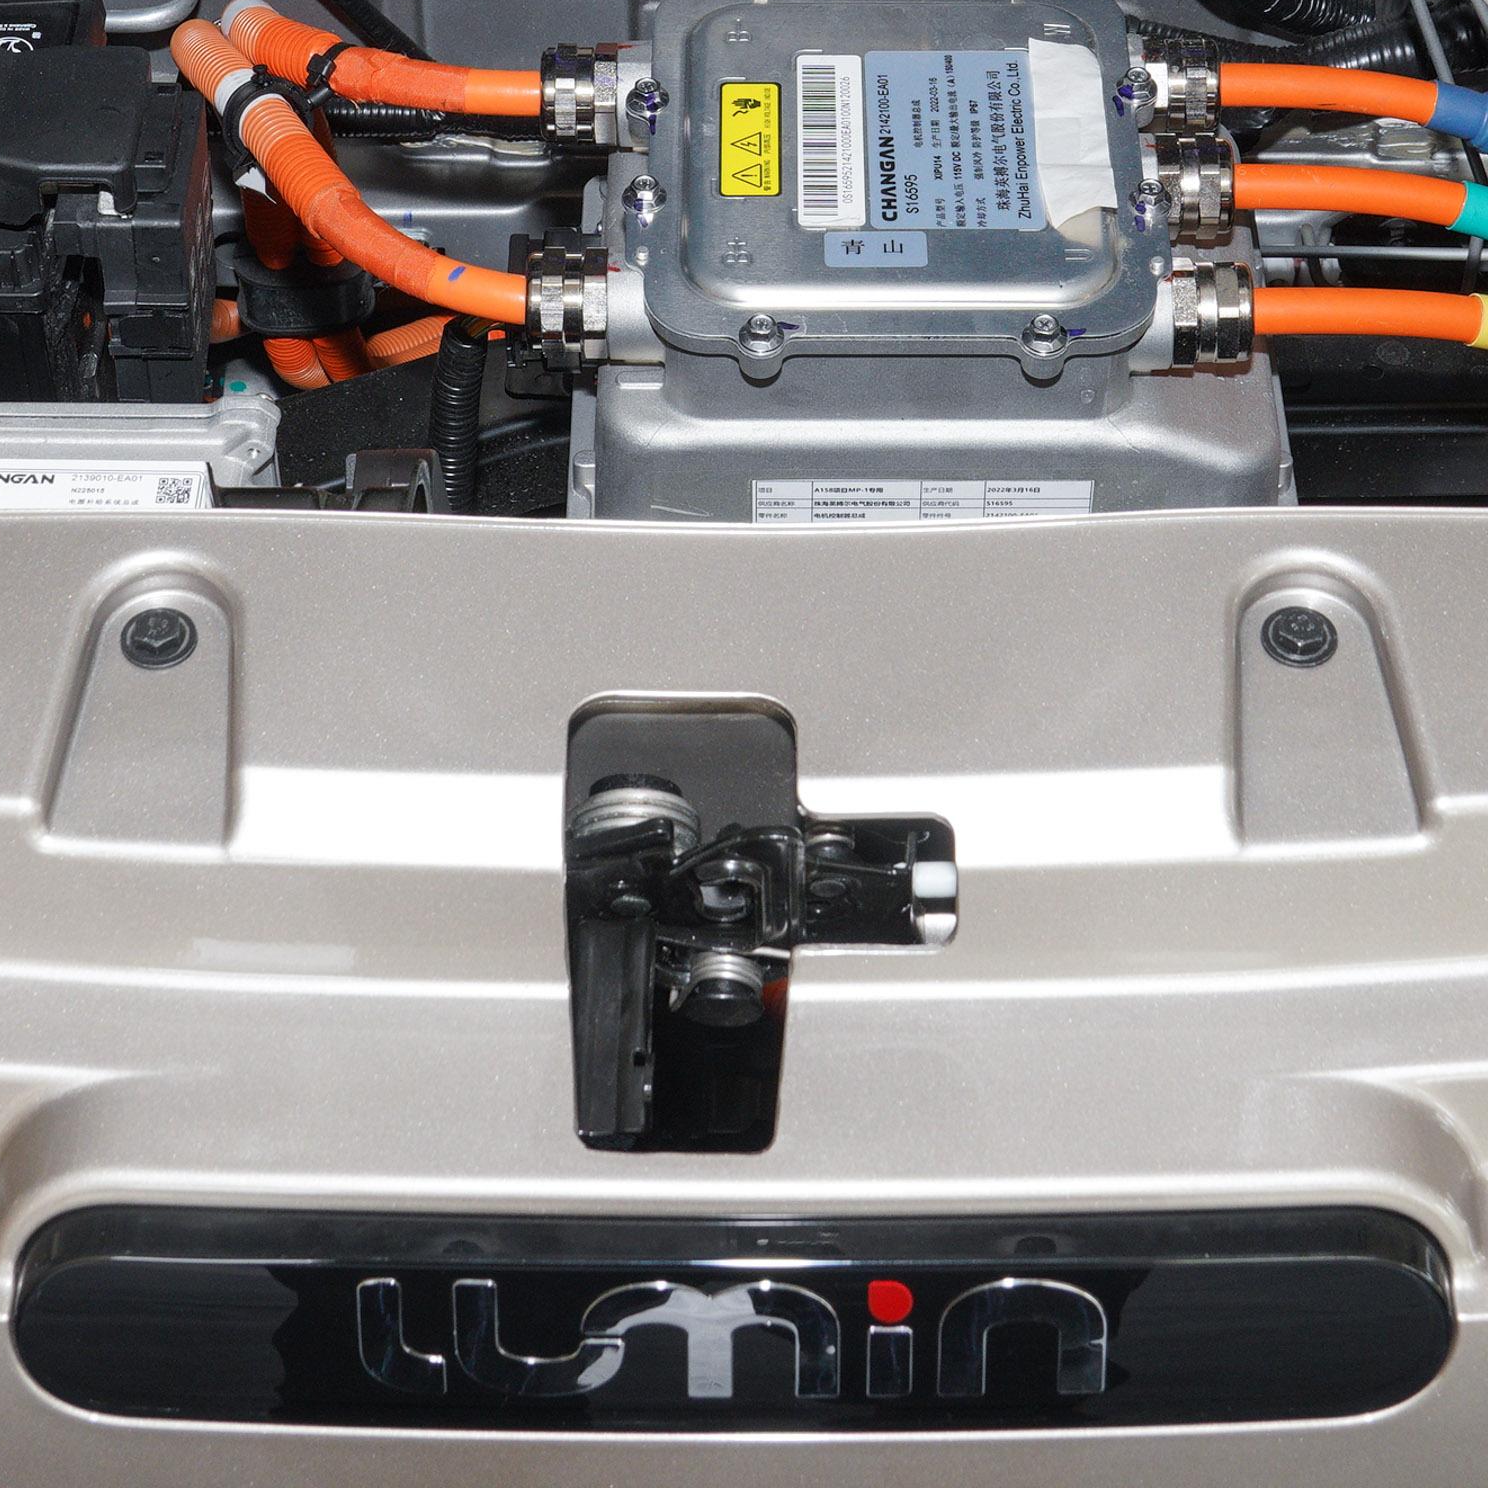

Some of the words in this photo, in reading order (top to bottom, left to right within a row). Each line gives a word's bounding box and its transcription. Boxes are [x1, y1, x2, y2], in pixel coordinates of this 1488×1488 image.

[877, 74, 891, 134] 2142100-EA01
[928, 77, 939, 112] 2022-03-16
[969, 100, 979, 113] IP67
[931, 120, 942, 148] 生产日期
[1009, 99, 1024, 133] Electric
[1013, 137, 1031, 179] Enpower
[879, 137, 897, 221] CHANGAN
[904, 174, 920, 214] S16595
[935, 198, 946, 227] 产品型号
[1016, 182, 1032, 219] ZhuHai
[72, 474, 143, 482] 2139010-EA01
[356, 1277, 1107, 1398] lumin
